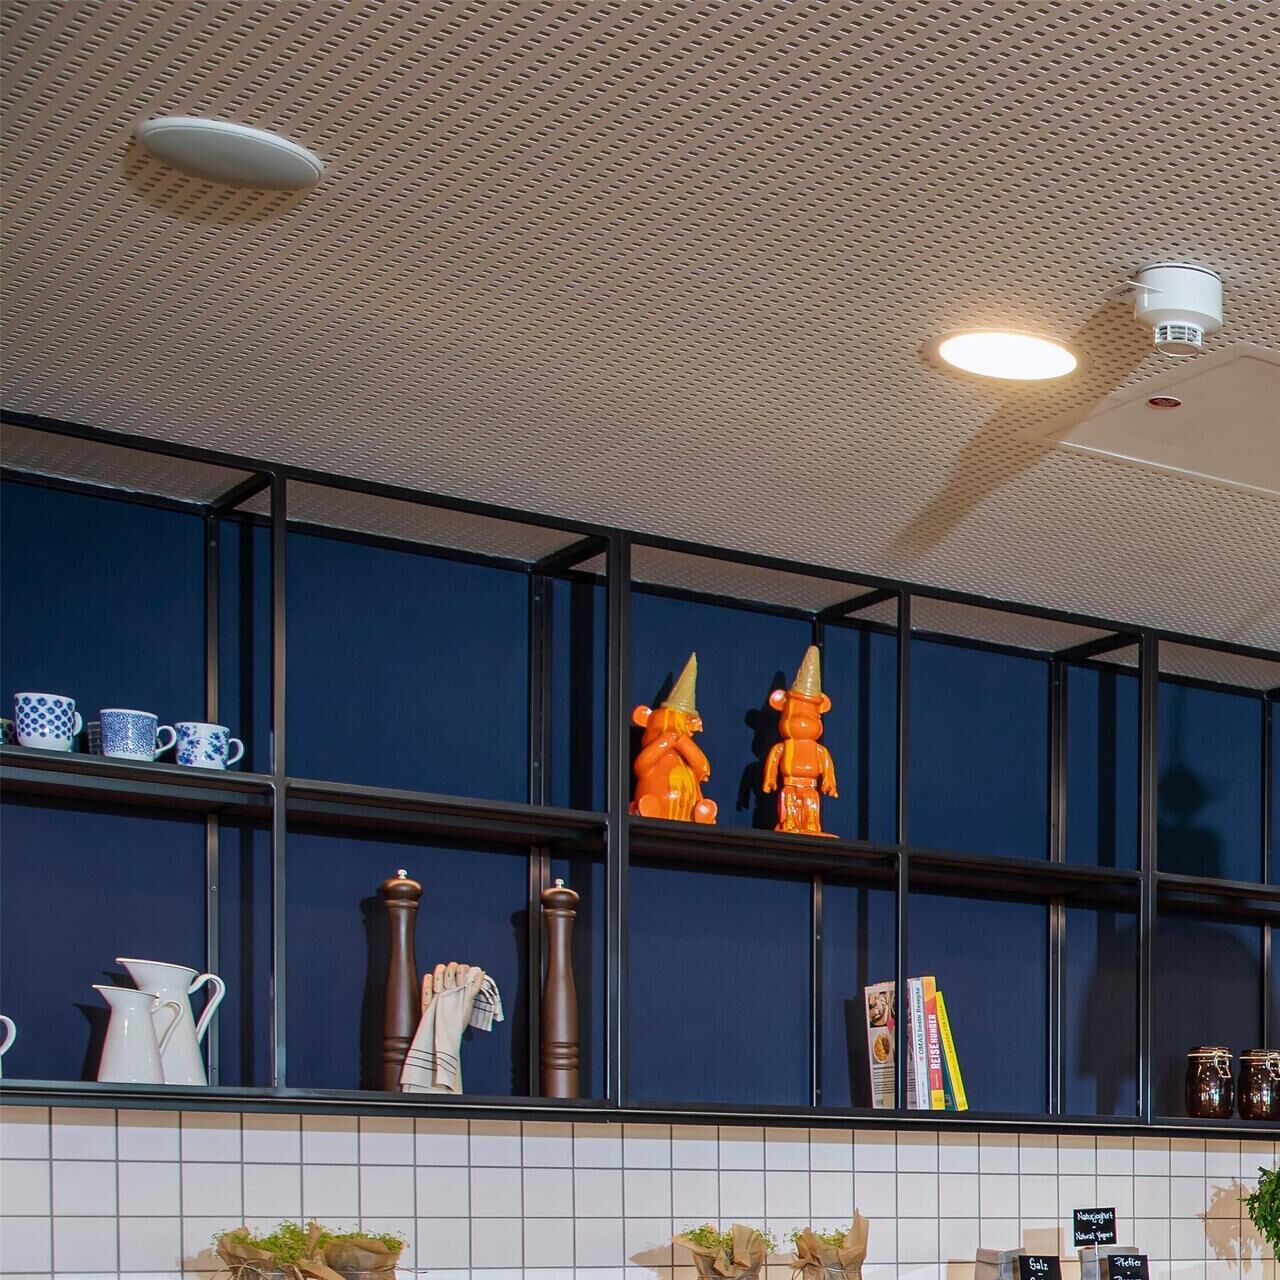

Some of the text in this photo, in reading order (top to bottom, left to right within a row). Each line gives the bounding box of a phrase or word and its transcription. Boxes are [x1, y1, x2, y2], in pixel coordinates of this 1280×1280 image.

[928, 1014, 941, 1069] REISEHUNGER
[1029, 1257, 1049, 1271] Salz
[1113, 1256, 1142, 1267] Pfeffer
